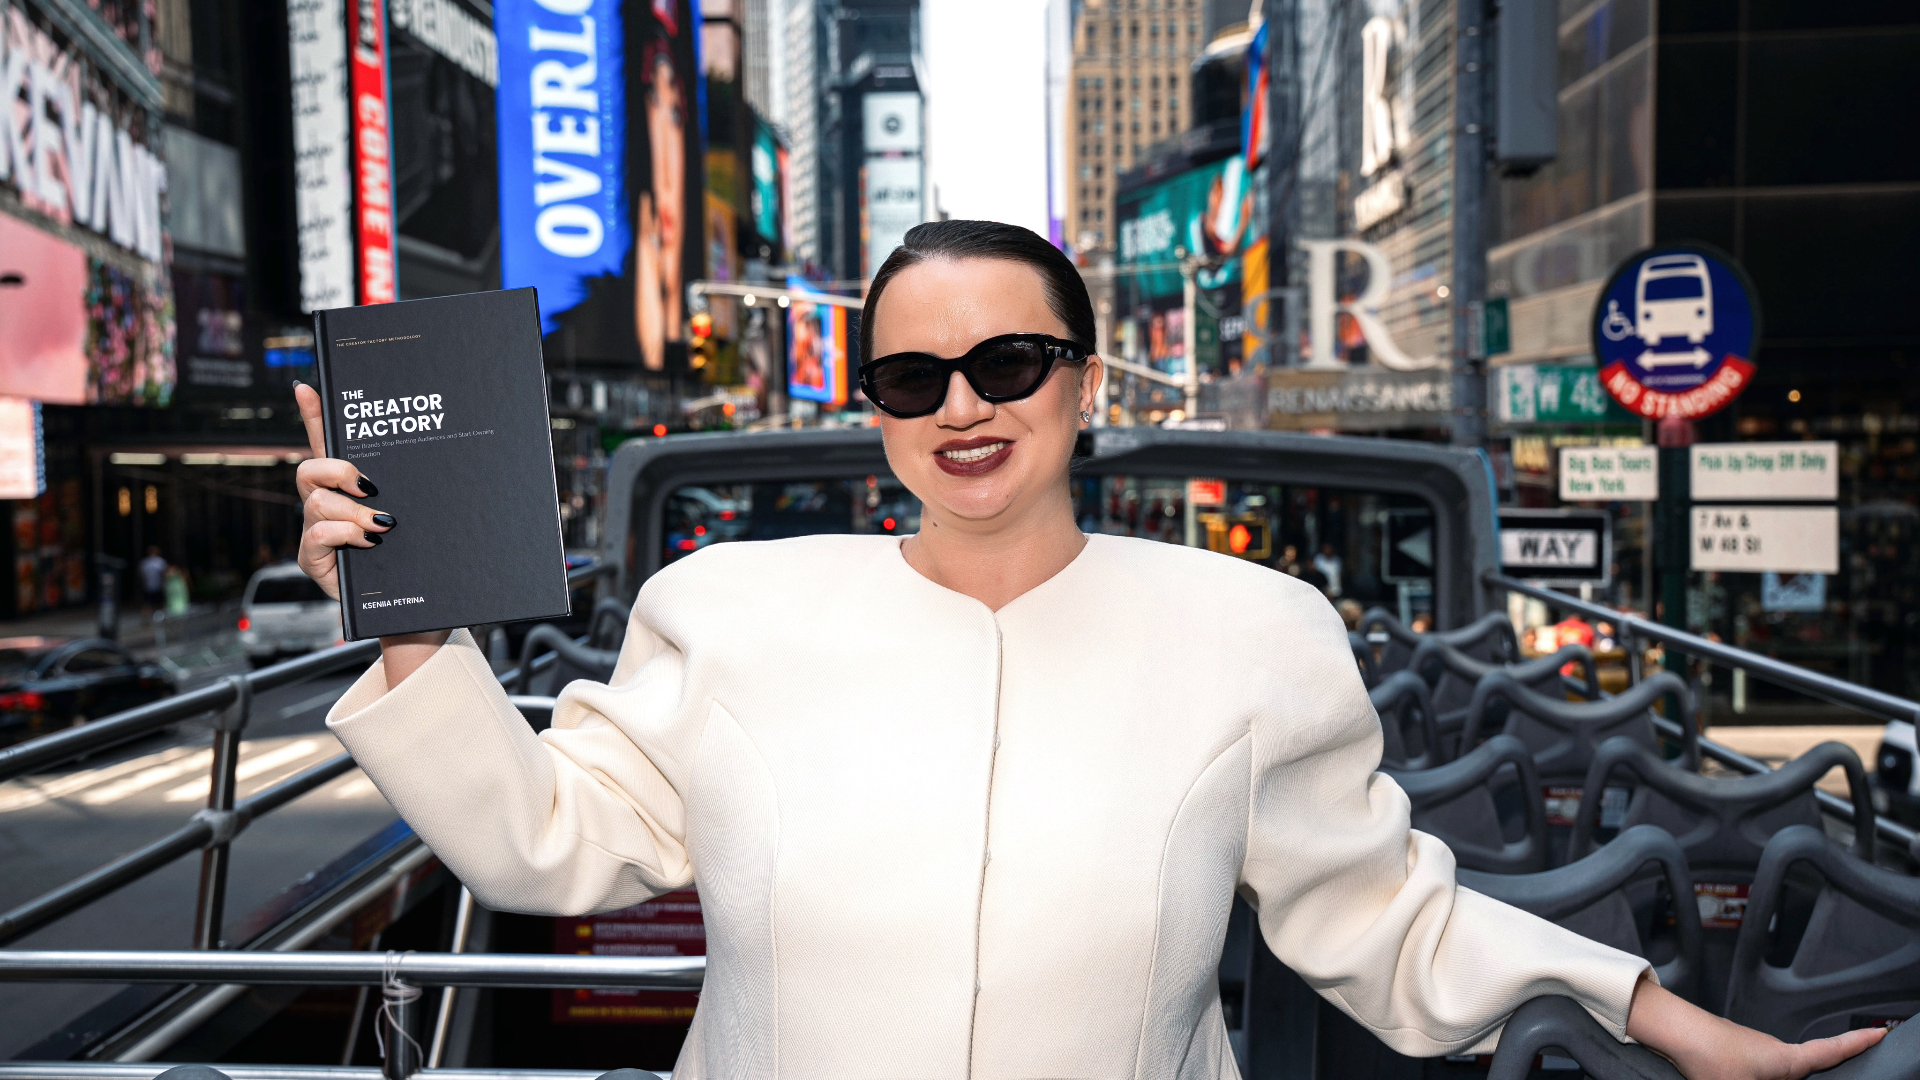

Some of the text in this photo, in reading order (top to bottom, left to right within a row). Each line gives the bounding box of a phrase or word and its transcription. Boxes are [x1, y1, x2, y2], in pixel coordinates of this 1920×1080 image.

[528, 0, 604, 258] OVERL
[357, 93, 390, 235] COME
[1298, 239, 1442, 370] R
[342, 389, 364, 401] THE
[1267, 381, 1451, 413] RENAISSANCE
[1607, 365, 1743, 419] NO STANDING
[343, 393, 442, 420] CREATOR
[345, 413, 445, 440] FACTORY
[396, 437, 416, 445] Renting
[418, 434, 445, 442] Audiences
[1569, 456, 1585, 473] Big
[1592, 456, 1612, 470] Bus
[1518, 533, 1582, 560] WAY
[362, 596, 425, 610] KSENIIA PETRINA
